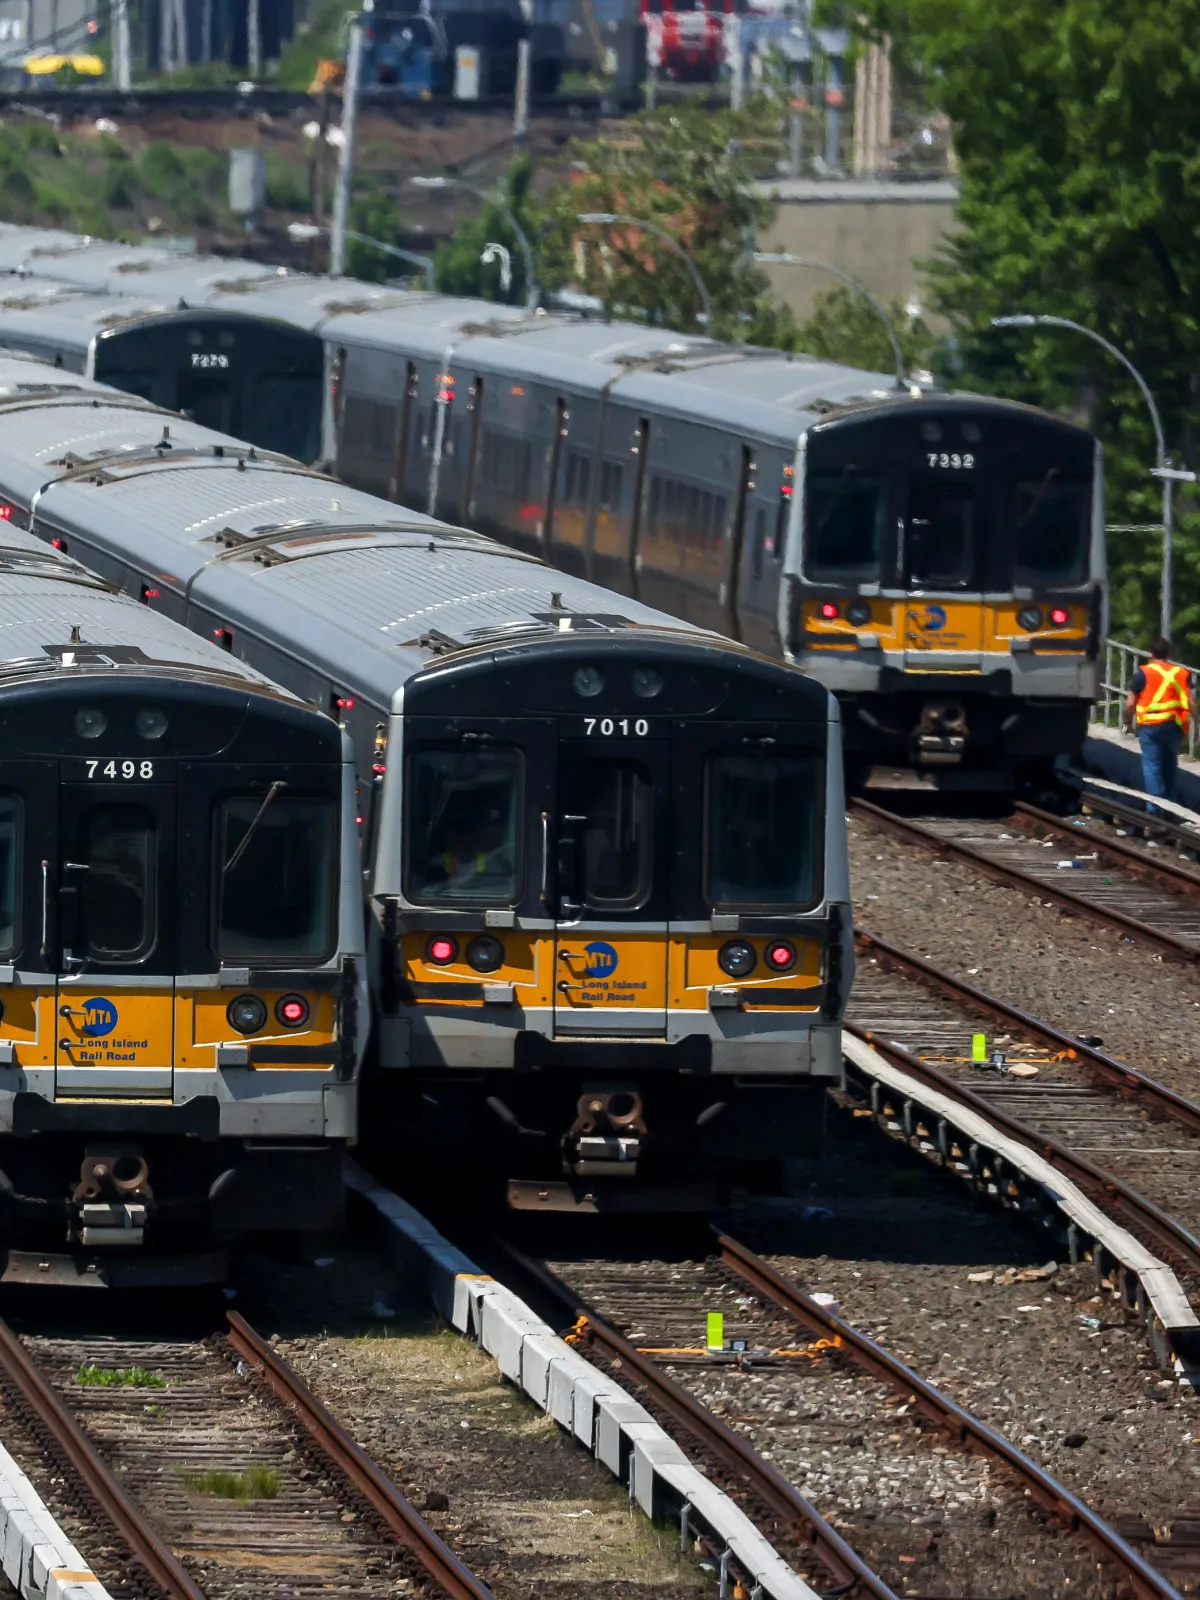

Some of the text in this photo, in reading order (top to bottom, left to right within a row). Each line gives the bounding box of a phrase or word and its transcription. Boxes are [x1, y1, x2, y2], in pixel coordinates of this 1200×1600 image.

[583, 718, 648, 736] 7010
[85, 760, 153, 779] 7498
[612, 980, 647, 989] Island
[582, 992, 635, 1001] Rail Road
[80, 1038, 148, 1049] Long Island
[80, 1051, 136, 1061] Rail Road
